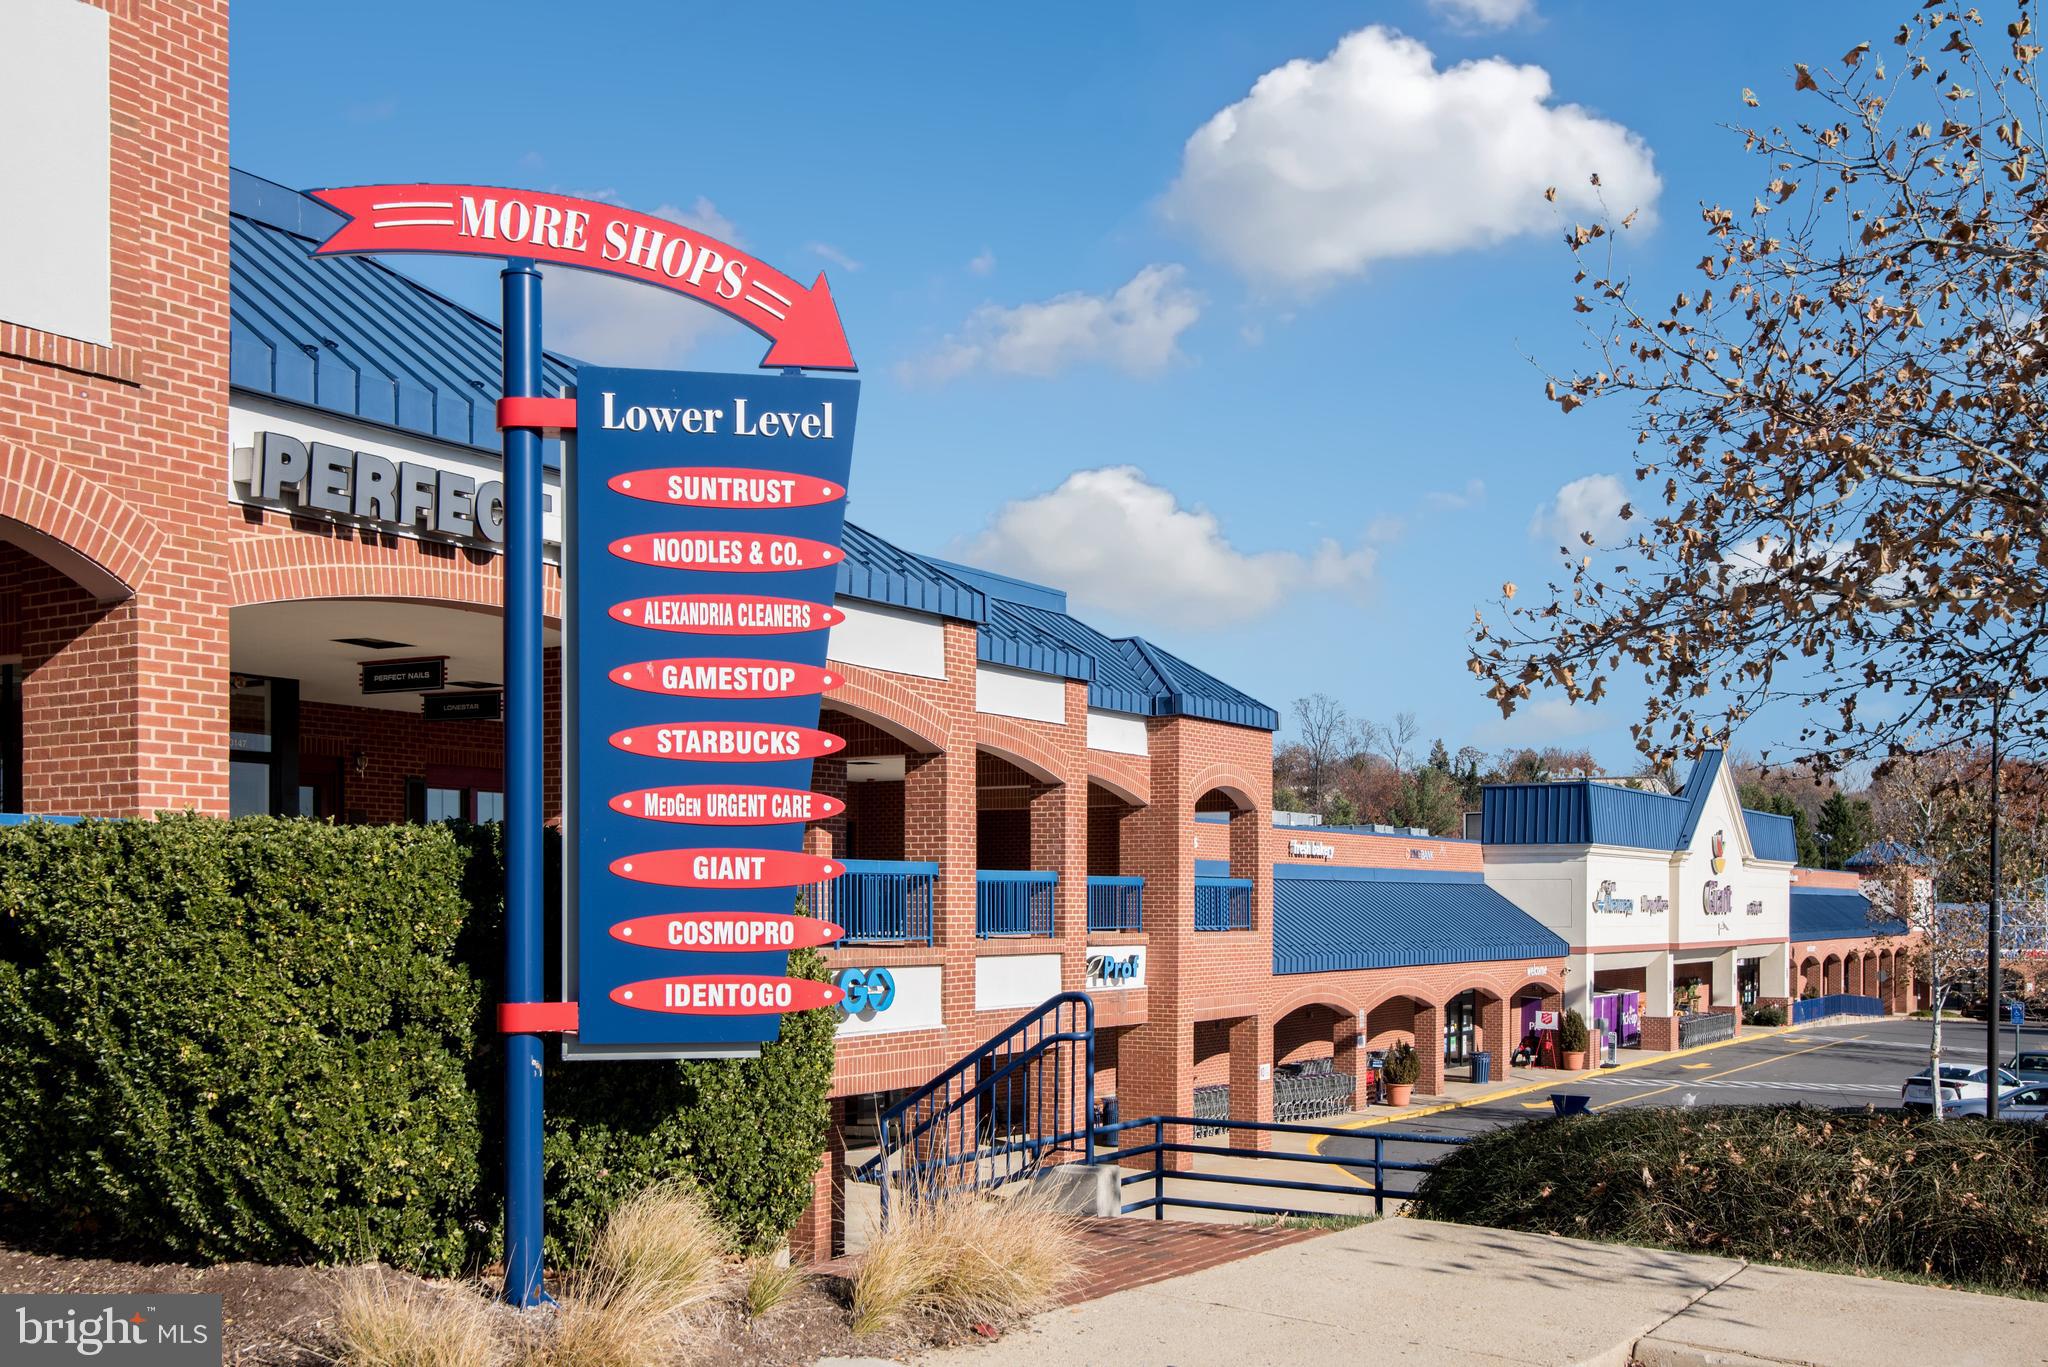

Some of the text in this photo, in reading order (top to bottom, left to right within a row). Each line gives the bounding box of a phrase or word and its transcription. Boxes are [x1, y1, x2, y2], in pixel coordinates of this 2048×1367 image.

[459, 196, 748, 299] MORE SHOPS
[603, 393, 833, 437] Lower Level
[668, 476, 795, 503] SUNTRUST
[654, 539, 802, 565] NOODLES & CO.
[645, 602, 810, 627] ALEXANDRIA CLEANERS
[374, 671, 430, 682] PERFECT NAILS
[663, 666, 795, 691] GAMESTOP
[658, 730, 799, 754] STARBUCKS
[707, 794, 766, 817] URGENT
[772, 795, 811, 817] CARE
[694, 856, 765, 879] GIANT
[669, 921, 793, 944] COSMOPRO
[666, 984, 791, 1006] IDENTOGO
